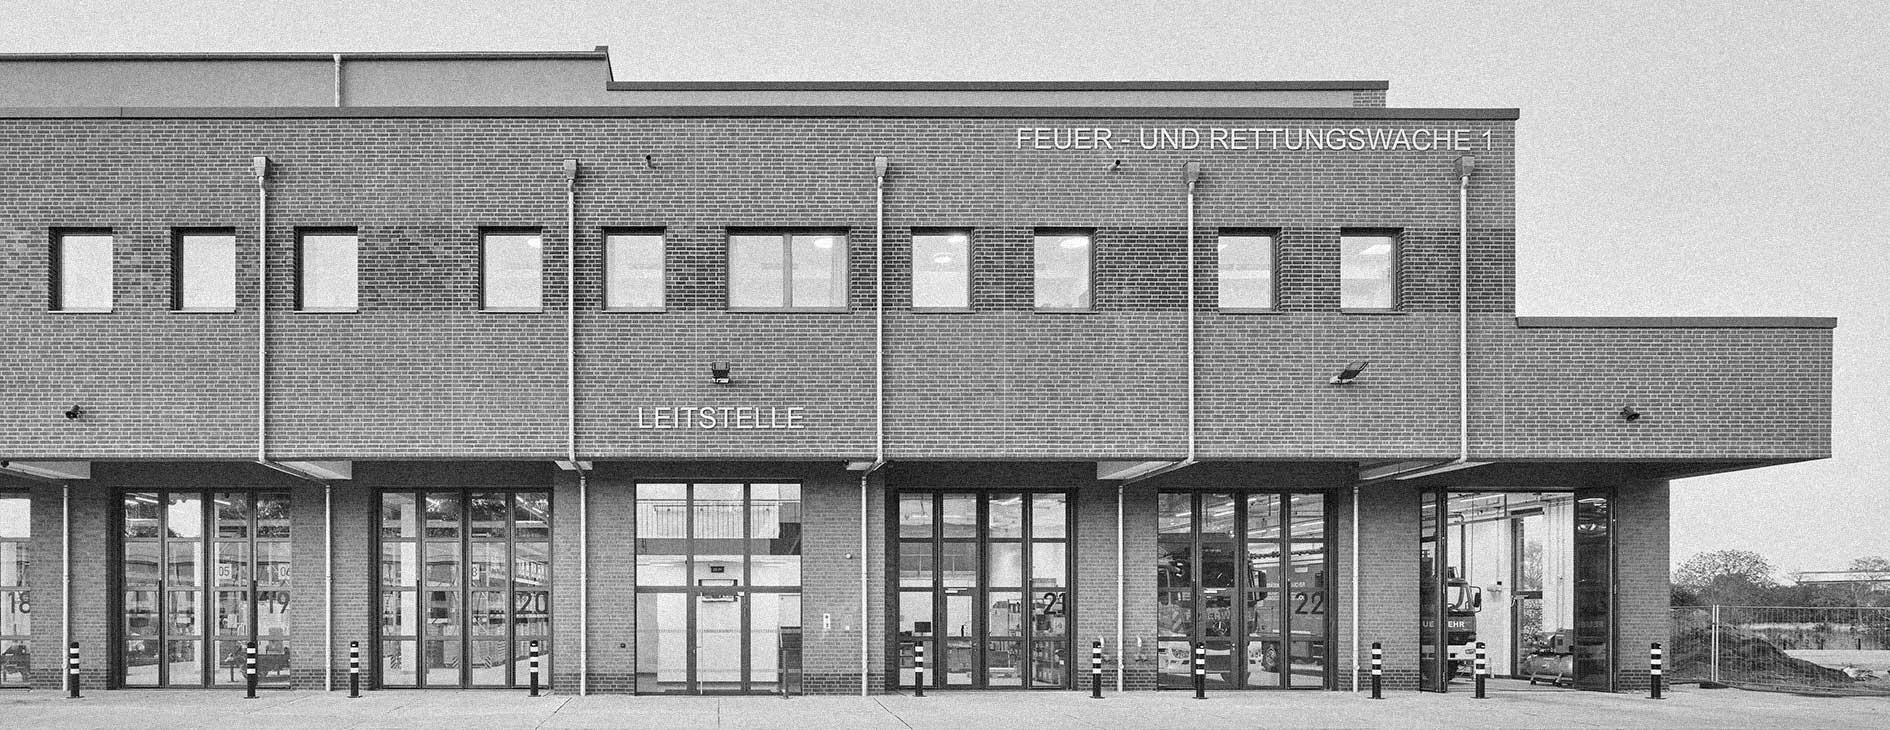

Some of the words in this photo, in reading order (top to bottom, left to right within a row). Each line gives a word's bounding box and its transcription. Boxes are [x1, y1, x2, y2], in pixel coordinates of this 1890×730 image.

[1016, 127, 1113, 150] FEUER
[1140, 127, 1200, 150] UND
[1210, 127, 1471, 151] RETTUNGSWACHE
[1482, 129, 1492, 151] 1
[638, 407, 805, 429] LEITSTELLE
[8, 591, 30, 614] 18
[268, 591, 290, 614] 19
[518, 591, 548, 614] 20
[1044, 592, 1066, 614] 21
[1295, 591, 1324, 614] 22
